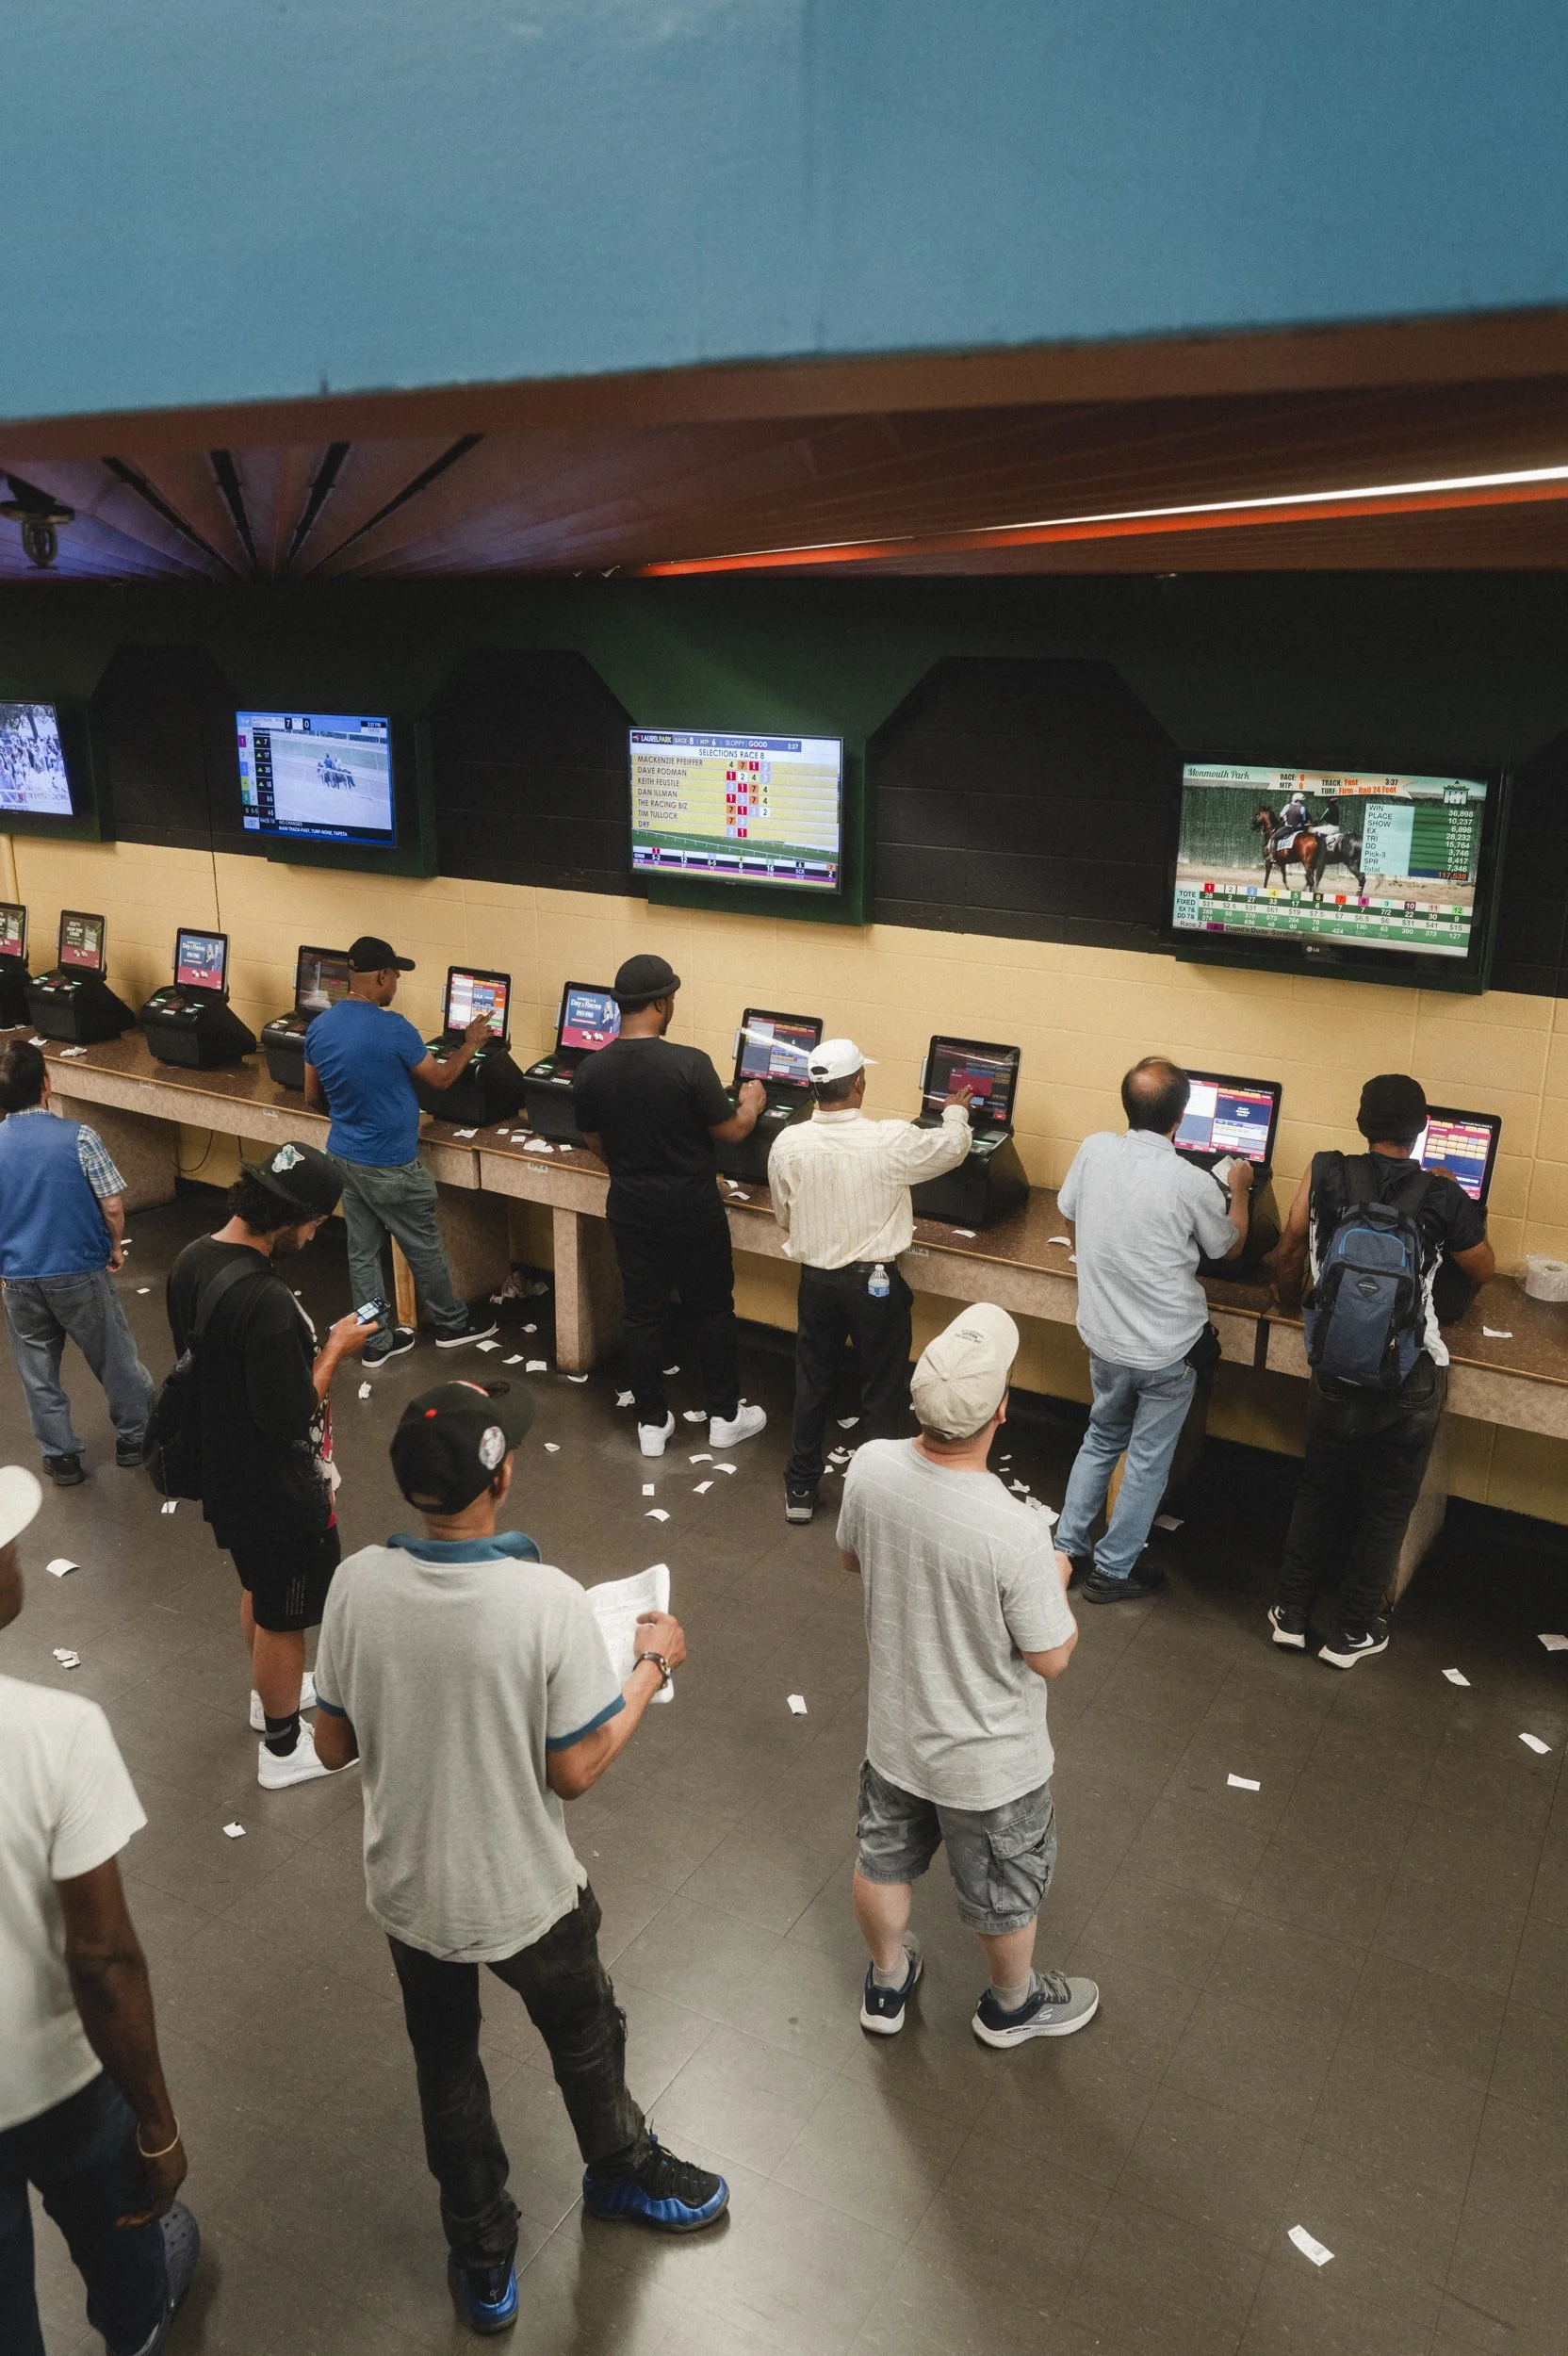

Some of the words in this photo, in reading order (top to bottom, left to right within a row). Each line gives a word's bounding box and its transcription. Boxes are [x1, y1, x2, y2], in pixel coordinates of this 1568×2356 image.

[699, 749, 737, 758] SELECTIONS
[638, 756, 675, 764] MACKENZIE
[1188, 768, 1229, 778] Monmouth
[1231, 771, 1250, 779] Park
[651, 800, 676, 809] RACING
[1226, 924, 1250, 934] Cupid's
